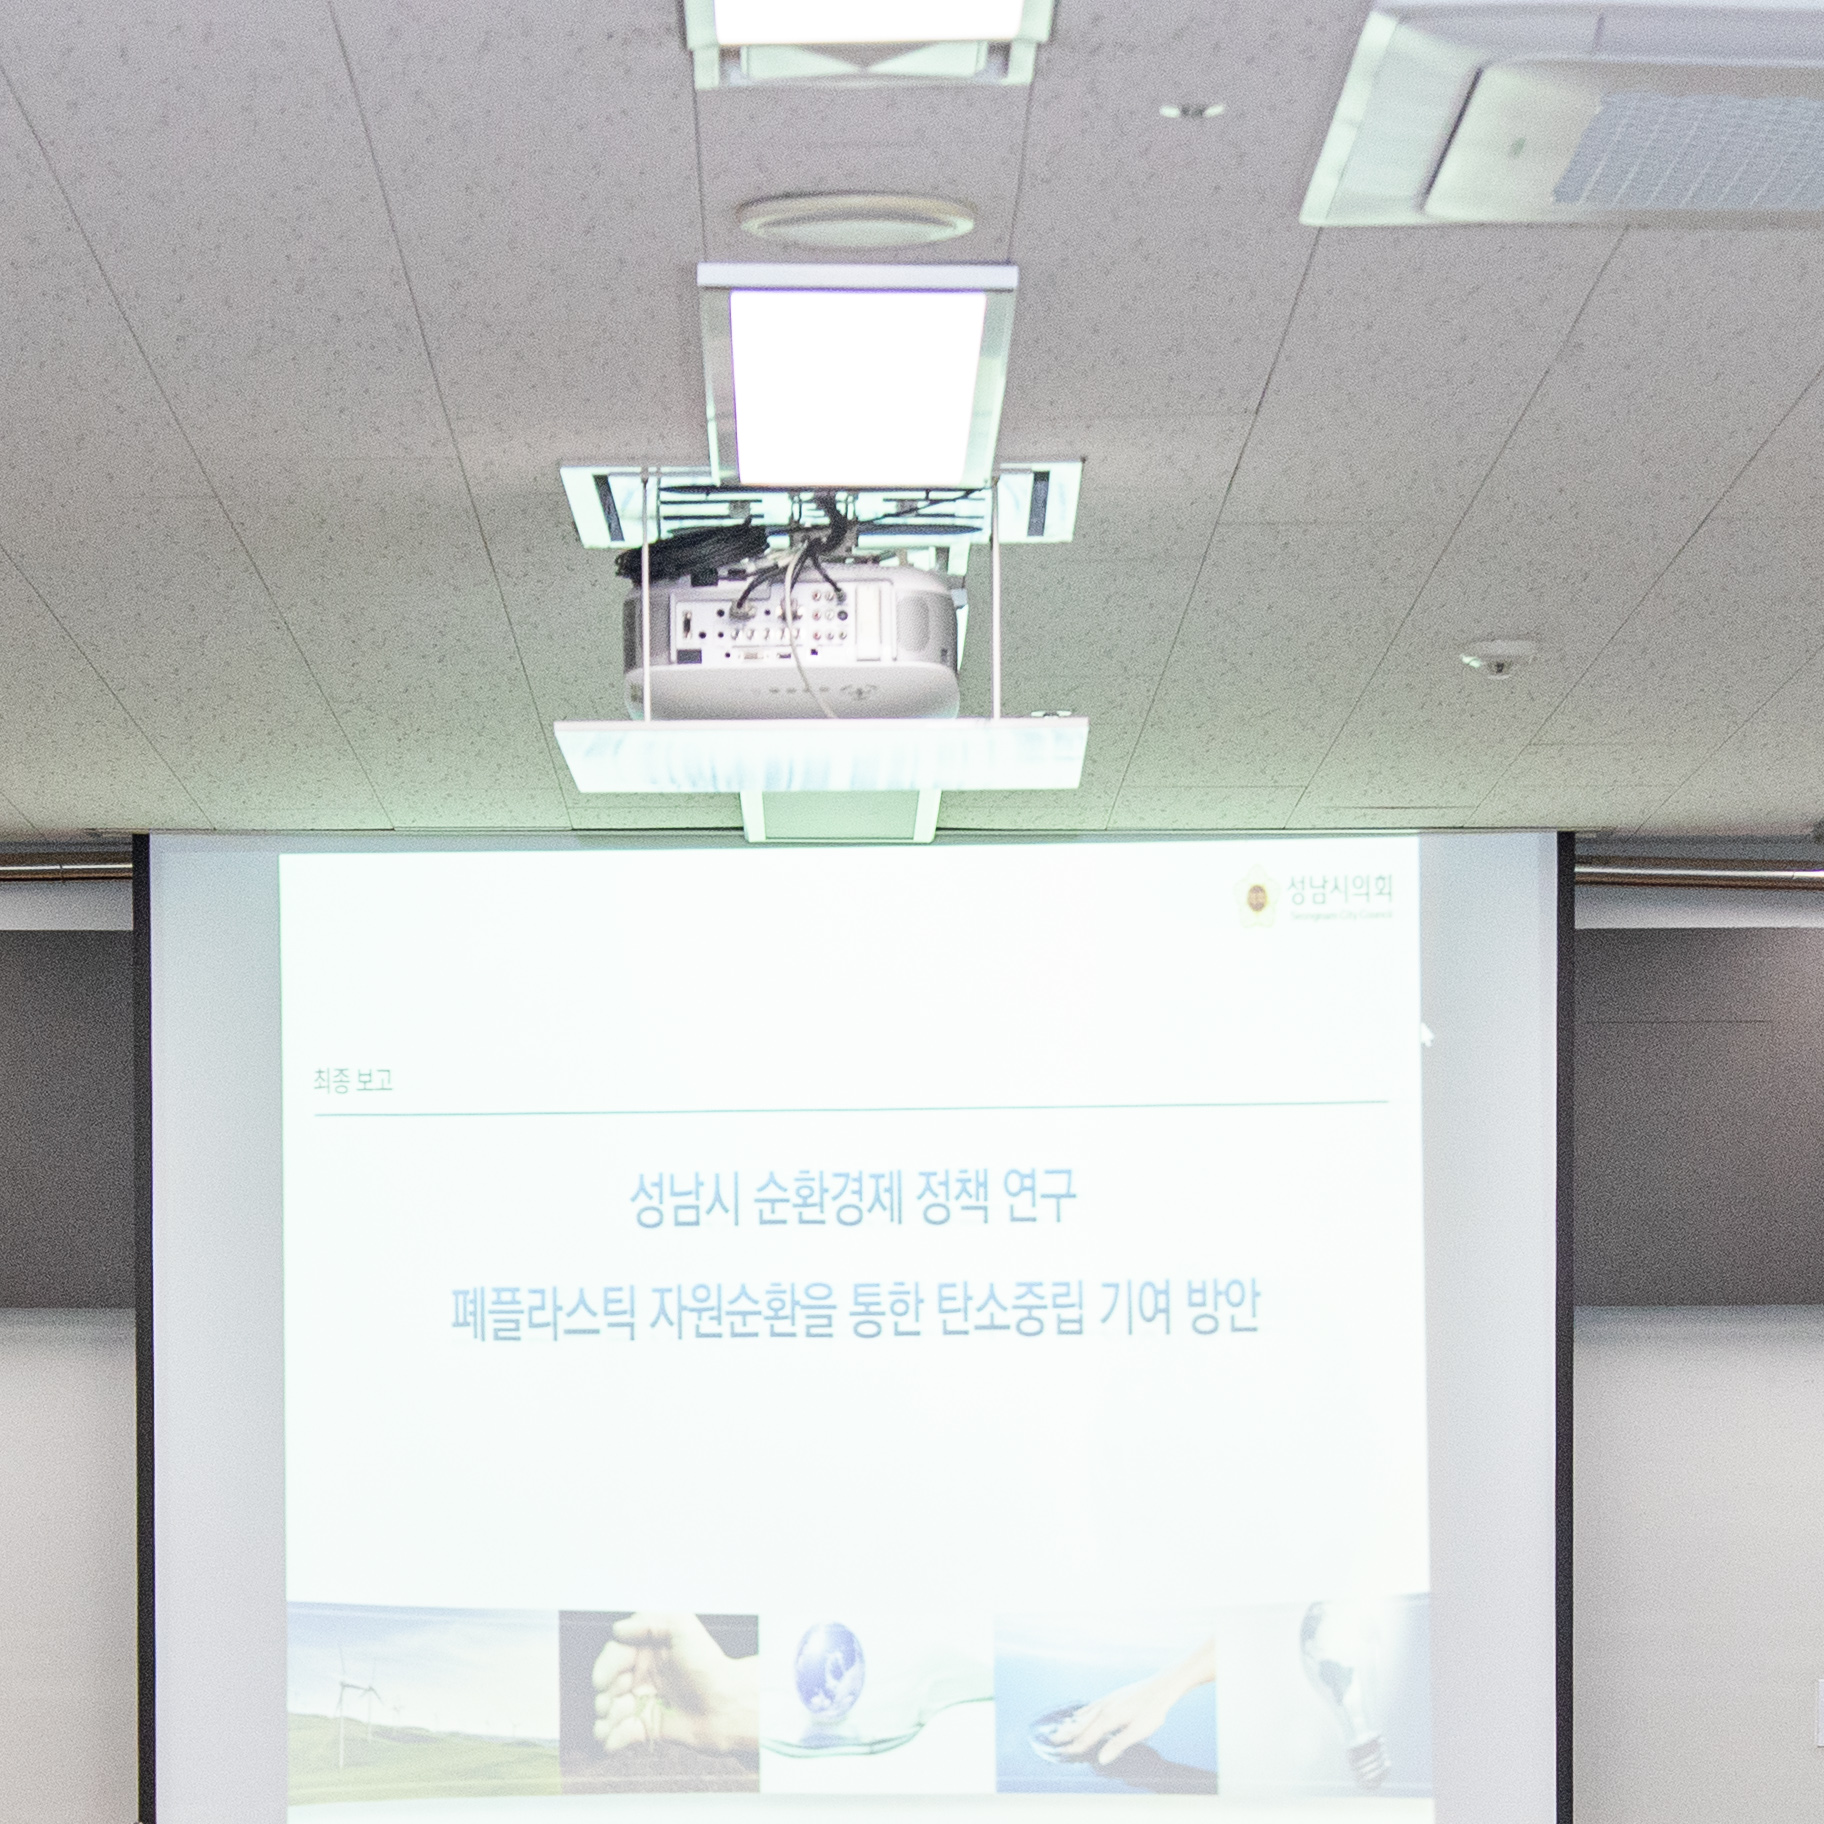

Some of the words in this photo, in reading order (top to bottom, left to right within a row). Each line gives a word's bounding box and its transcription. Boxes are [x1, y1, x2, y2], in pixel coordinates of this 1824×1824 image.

[1287, 874, 1393, 906] 성남시의회
[314, 1068, 350, 1095] 최종
[356, 1069, 393, 1092] 보고
[630, 1171, 739, 1229] 성남시
[754, 1170, 903, 1227] 순환경제
[916, 1168, 989, 1226] 정책
[1003, 1168, 1077, 1223] 연구
[451, 1285, 636, 1342] 폐플라스틱
[649, 1282, 838, 1340] 자원순환을
[849, 1281, 925, 1339] 통한
[938, 1280, 1084, 1337] 탄소중립
[1100, 1278, 1171, 1336] 기여
[1187, 1277, 1262, 1336] 방안
